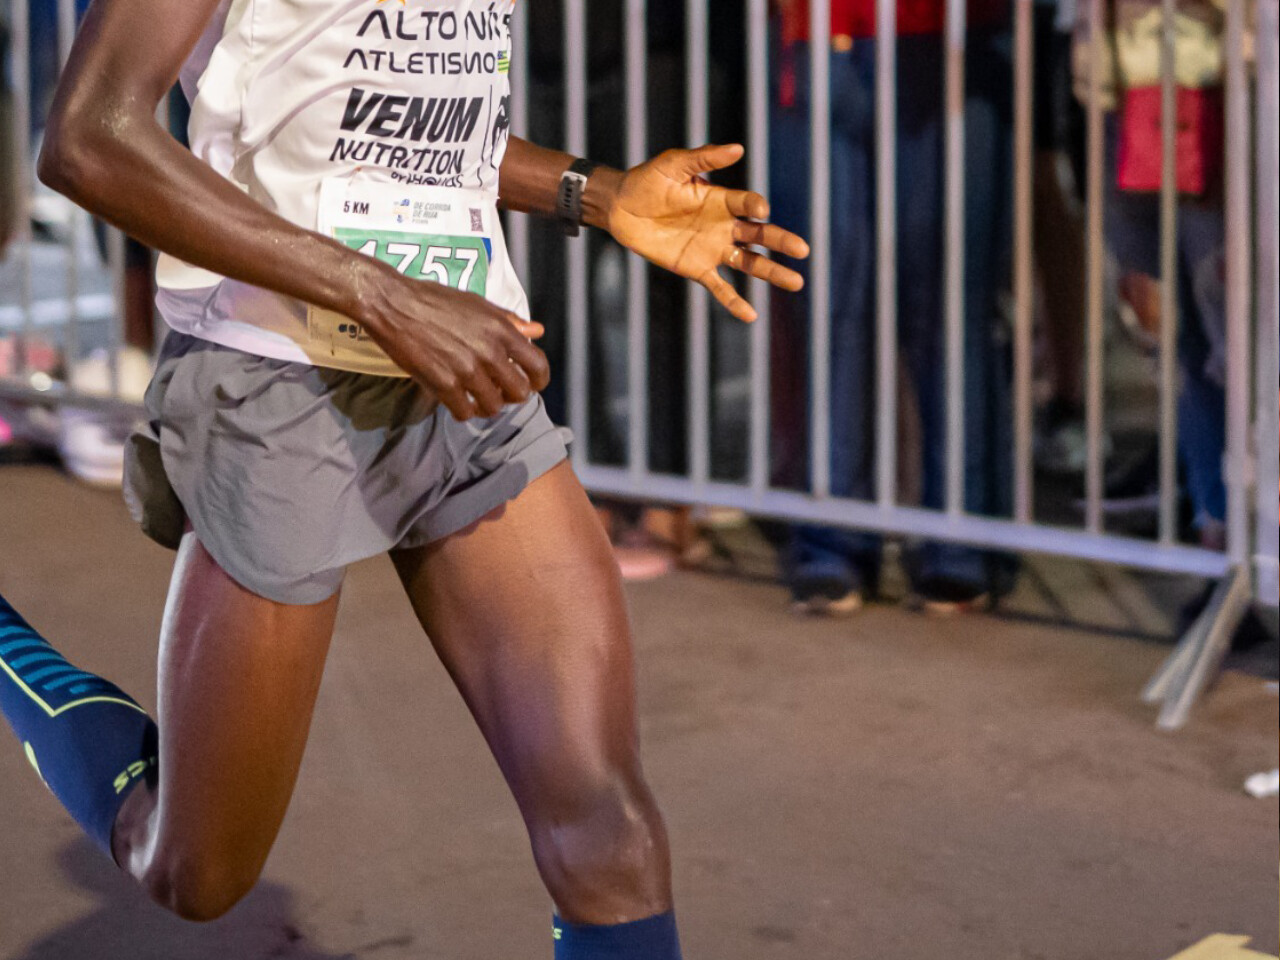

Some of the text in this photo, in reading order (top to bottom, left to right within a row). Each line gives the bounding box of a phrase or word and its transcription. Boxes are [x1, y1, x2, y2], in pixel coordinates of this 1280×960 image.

[356, 8, 458, 41] ALTO
[340, 87, 483, 143] VENUM
[329, 138, 465, 175] NUTRITION
[343, 200, 370, 215] 5 KM
